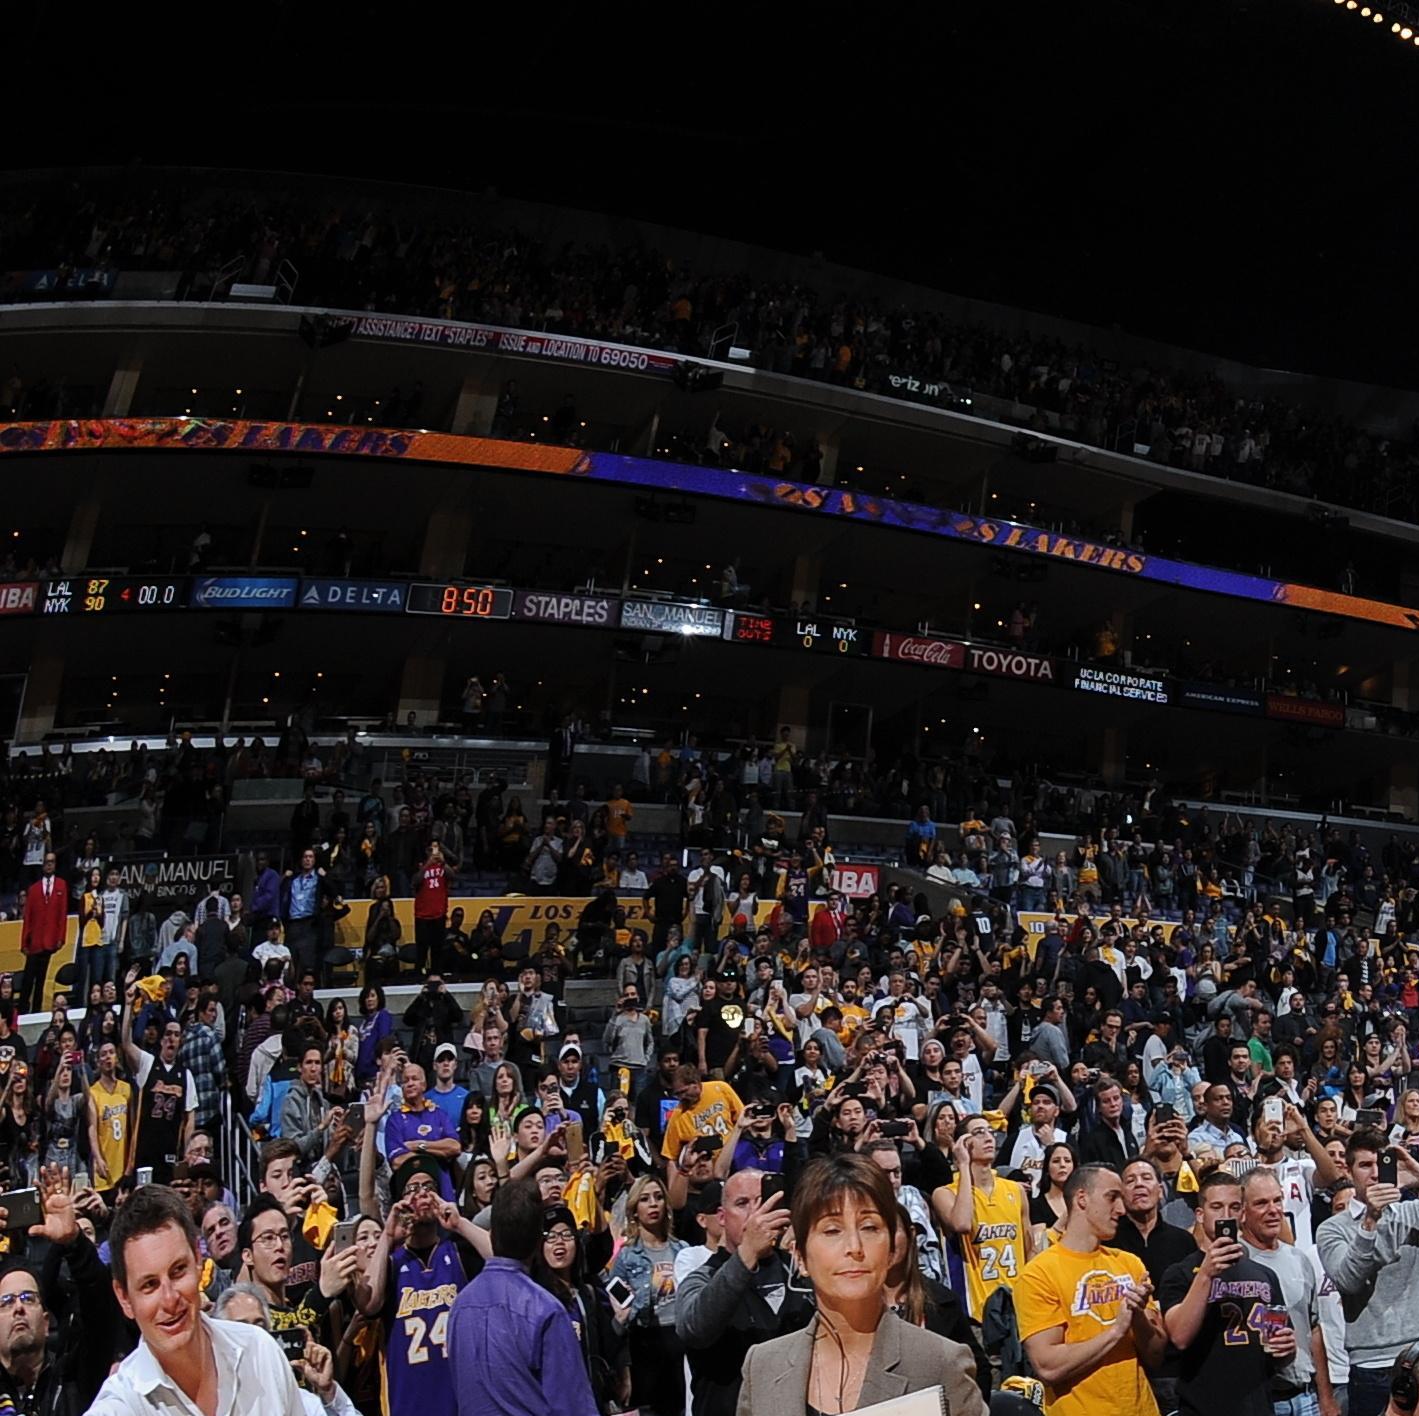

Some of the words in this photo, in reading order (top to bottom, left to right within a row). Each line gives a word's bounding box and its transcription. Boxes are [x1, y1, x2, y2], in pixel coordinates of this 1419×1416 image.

[357, 318, 418, 341] ASSISTANCE?
[419, 324, 445, 343] TEXT
[499, 333, 526, 352] ISSUE
[542, 340, 587, 360] LOCATION
[587, 347, 600, 362] TO
[600, 348, 649, 370] 69050
[1004, 527, 1146, 574] LAKERS
[47, 581, 73, 597] LAL
[88, 579, 110, 594] 87
[138, 586, 175, 605] 00.0
[327, 586, 401, 605] DELTA
[43, 597, 71, 614] NYK
[84, 596, 106, 611] 90
[441, 587, 494, 616] 8:50
[522, 595, 609, 623] STAPLES
[622, 601, 652, 618] SAN
[663, 606, 723, 625] MANUEL
[796, 622, 821, 637] LAL
[832, 626, 857, 641] NYK
[803, 636, 813, 648] 0
[838, 640, 848, 653] 0
[970, 649, 1053, 679] TOYOTA
[1105, 672, 1163, 692] CORPORATE
[1122, 687, 1169, 704] SERVICES
[119, 863, 144, 885] AN
[530, 904, 574, 920] LOS
[975, 917, 992, 934] 10
[151, 1093, 177, 1120] 24
[112, 1119, 123, 1141] 8
[972, 1223, 1017, 1244] LAKERS
[979, 1243, 1018, 1281] 24
[1207, 1277, 1273, 1302] LAKERS
[395, 1284, 458, 1319] LAKERS
[404, 1312, 449, 1365] 24
